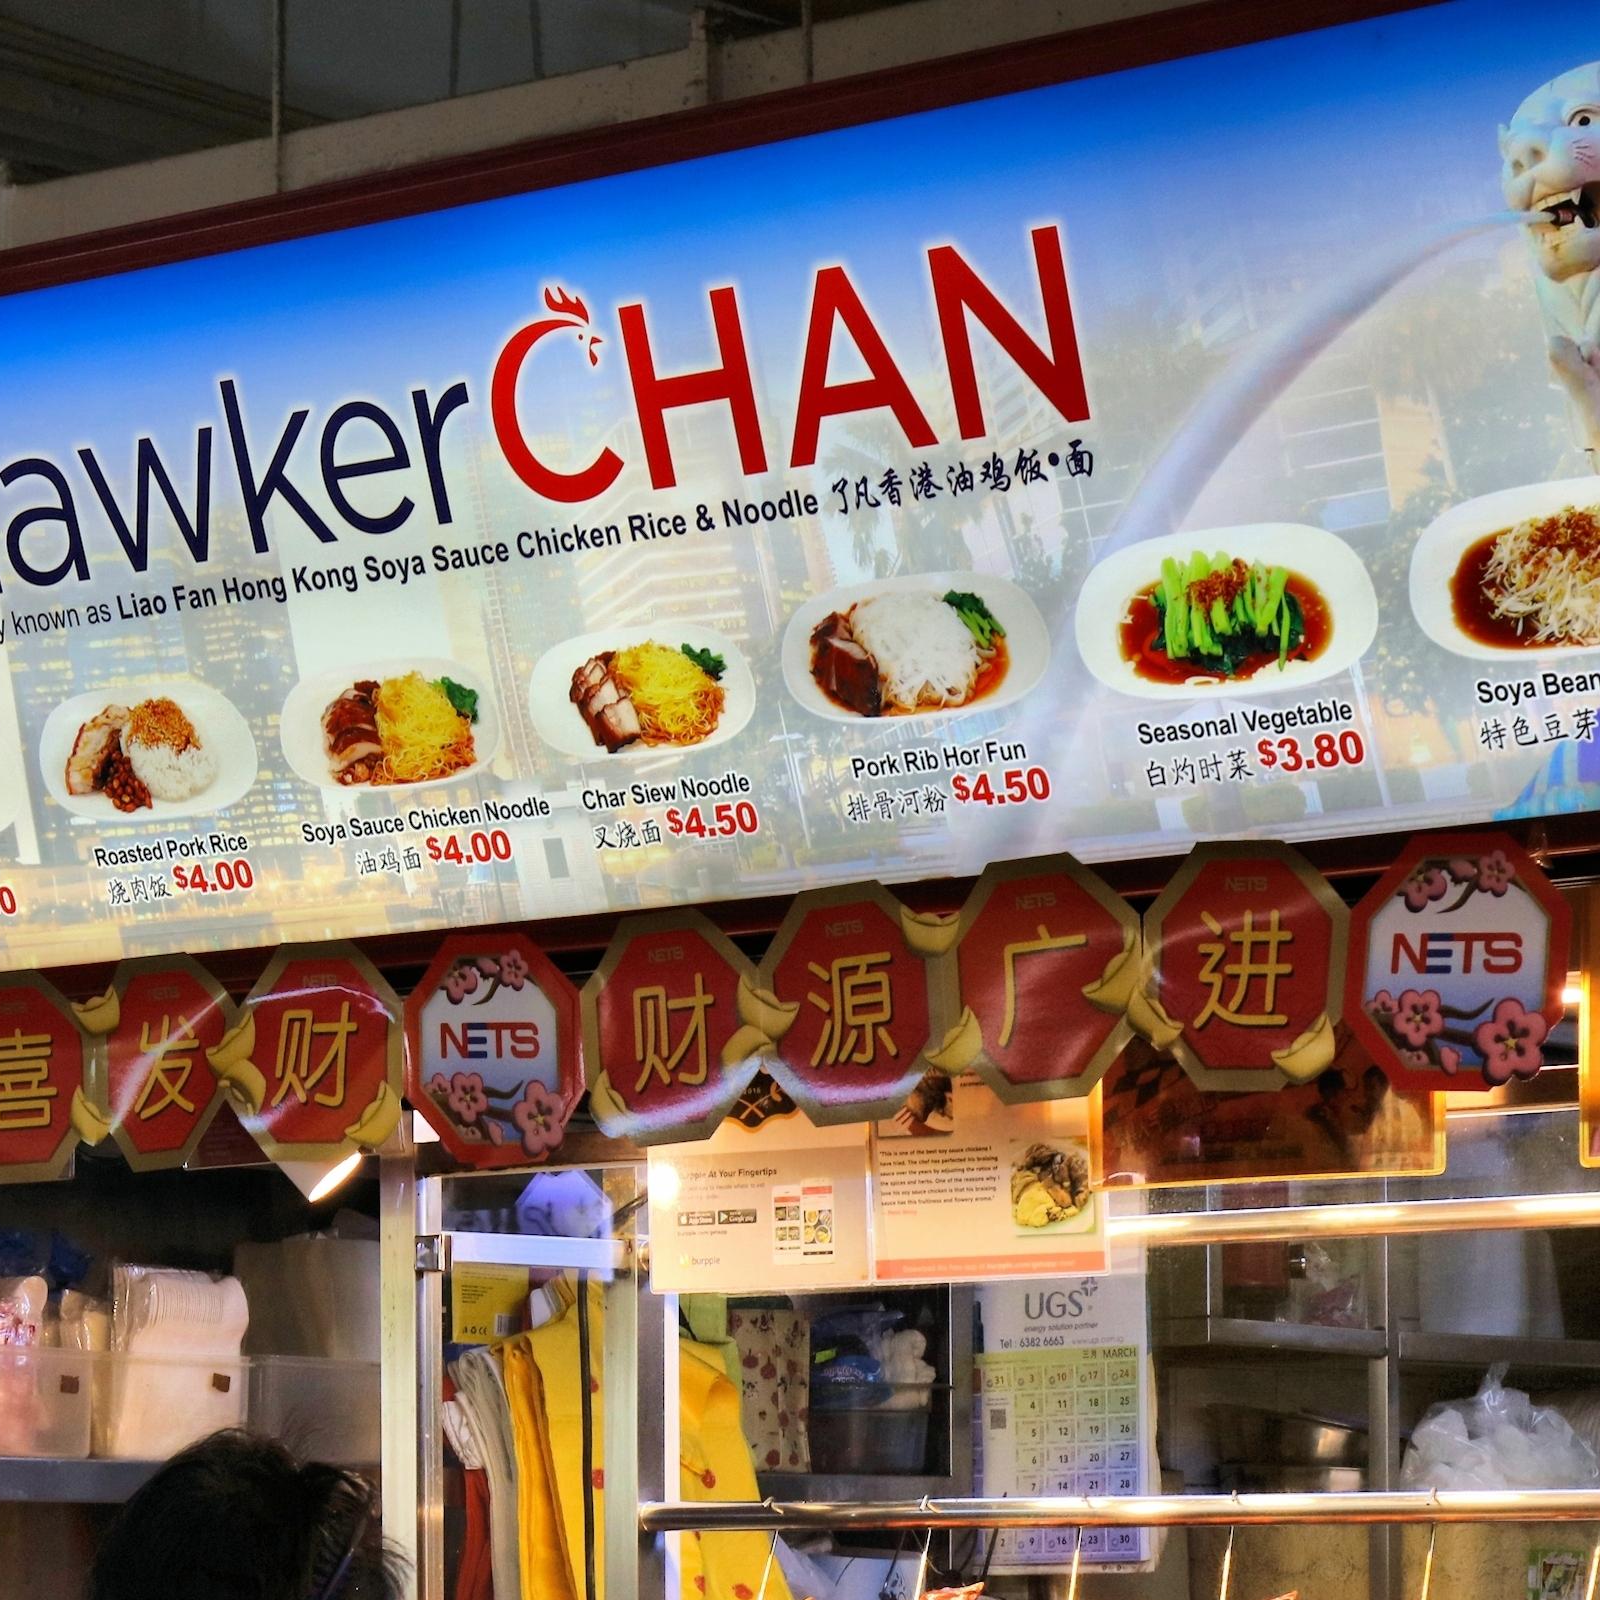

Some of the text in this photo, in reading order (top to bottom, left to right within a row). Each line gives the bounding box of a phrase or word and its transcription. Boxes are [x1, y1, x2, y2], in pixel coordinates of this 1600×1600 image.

[10, 603, 82, 637] known
[86, 604, 113, 627] as
[116, 588, 167, 621] Liao
[173, 582, 219, 612] Fan
[222, 570, 288, 607] Hong
[292, 562, 359, 595] Kong
[365, 552, 426, 585] Soya
[432, 540, 510, 575] Sauce
[517, 522, 622, 562] Chicken
[630, 510, 687, 545] Rice
[695, 503, 716, 533] &
[723, 489, 819, 530] Noodle
[1476, 675, 1537, 707] Soya
[1137, 699, 1353, 746] Seasonal Vegetable
[1479, 706, 1594, 751] 特色豆芽
[852, 741, 1027, 779] Pork Rib Hor Fun
[1144, 731, 1365, 788] 白灼时菜 $3.80
[582, 772, 750, 812] Char Siew Noodle
[847, 766, 1051, 823] 排骨河粉 $4.50
[301, 797, 551, 845] Soya Sauce Chicken Noodle
[593, 801, 759, 851] 叉烧面 $4.50
[94, 834, 248, 867] Roasted Pork Rice
[356, 829, 512, 876] 油鸡面 $4.00
[108, 859, 254, 905] 烧肉饭 $4.00
[1390, 931, 1523, 975] NETS
[632, 909, 1293, 1094] 财 源 广 进
[133, 1014, 200, 1121] 发
[271, 1000, 358, 1108] 财
[439, 1021, 540, 1060] NETS
[708, 1168, 777, 1178] At Your Fingertips
[1024, 1290, 1084, 1320] UGS
[1024, 1322, 1098, 1332] energy solution partner
[1019, 1337, 1040, 1348] 6382
[1043, 1336, 1064, 1346] 6663
[1103, 1348, 1136, 1358] MARCH
